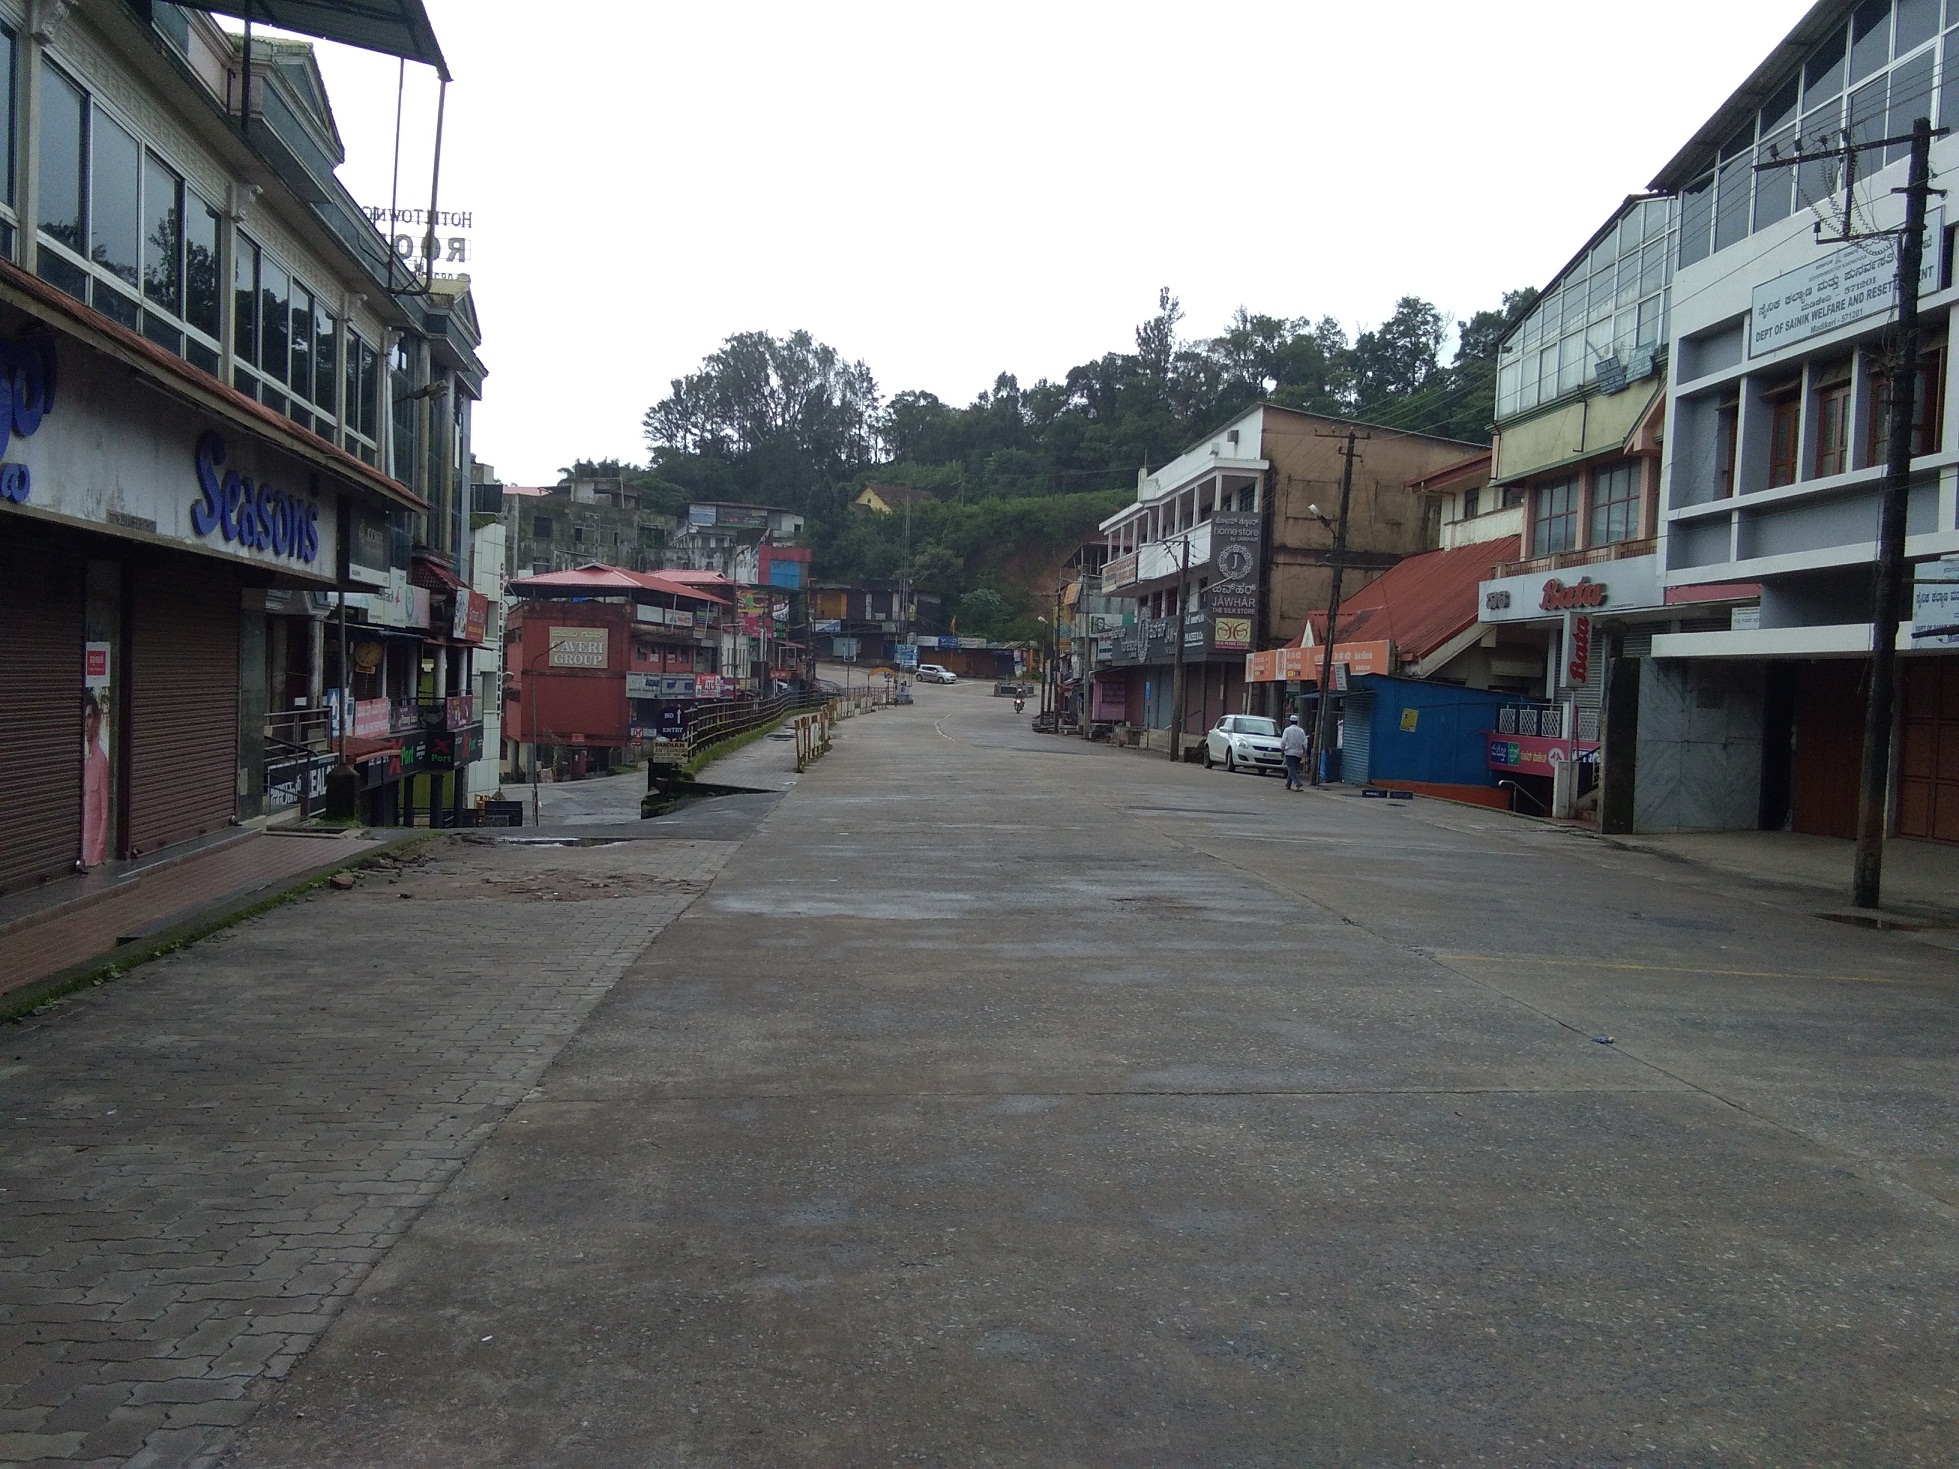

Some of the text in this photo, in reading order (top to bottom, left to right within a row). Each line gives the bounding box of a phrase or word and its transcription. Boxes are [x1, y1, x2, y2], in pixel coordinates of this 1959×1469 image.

[1844, 276, 1876, 294] 571201
[1756, 325, 1773, 342] DEPT
[1774, 321, 1785, 336] OF
[1785, 312, 1810, 332] SAINIK
[1811, 298, 1846, 322] WELFARE
[1847, 291, 1865, 308] AND
[1810, 318, 1837, 334] Madikeri
[1841, 308, 1864, 325] 571201
[190, 430, 319, 563] Seasons
[1238, 528, 1259, 536] store
[1539, 578, 1604, 610] Bata
[552, 640, 604, 654] CAVERI
[1570, 616, 1590, 684] Bata
[554, 654, 602, 666] GROUP
[431, 754, 452, 762] Port
